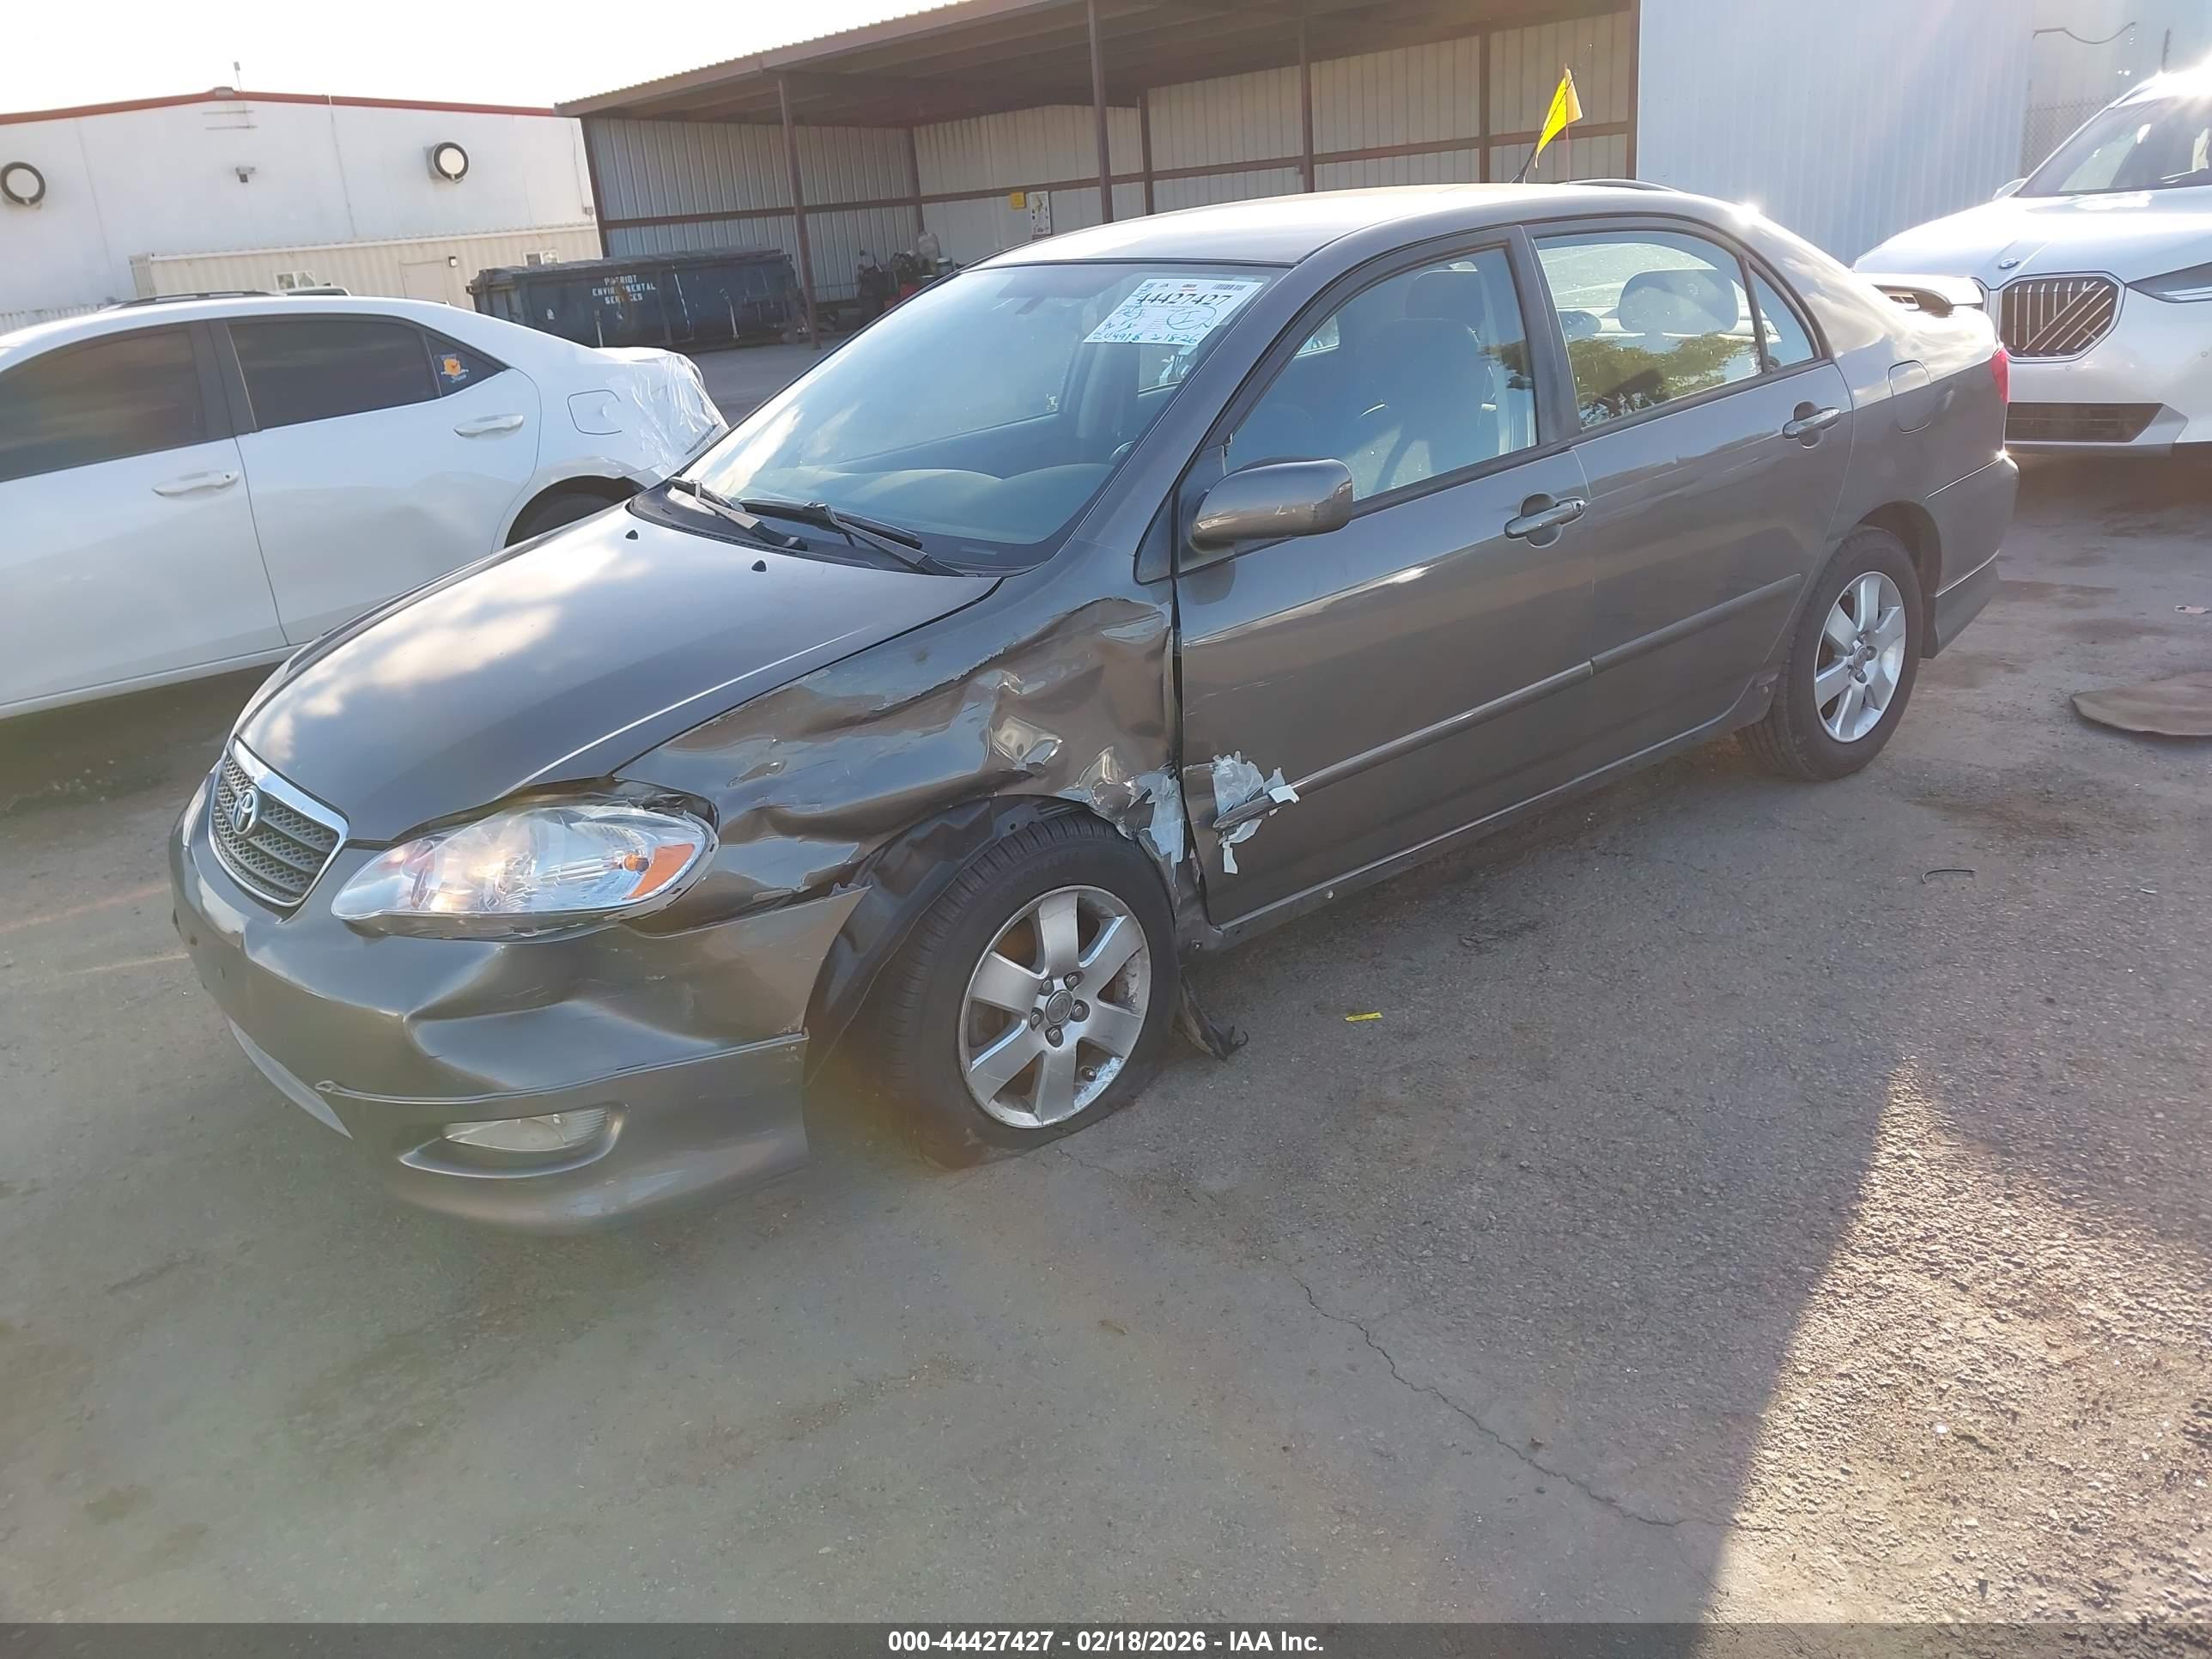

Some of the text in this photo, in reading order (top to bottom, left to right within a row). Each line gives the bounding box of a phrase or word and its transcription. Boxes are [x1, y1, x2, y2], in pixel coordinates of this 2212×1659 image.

[604, 274, 637, 286] PATRIOT
[592, 282, 657, 296] ENVIRMENTAL
[1137, 292, 1234, 307] 44427427
